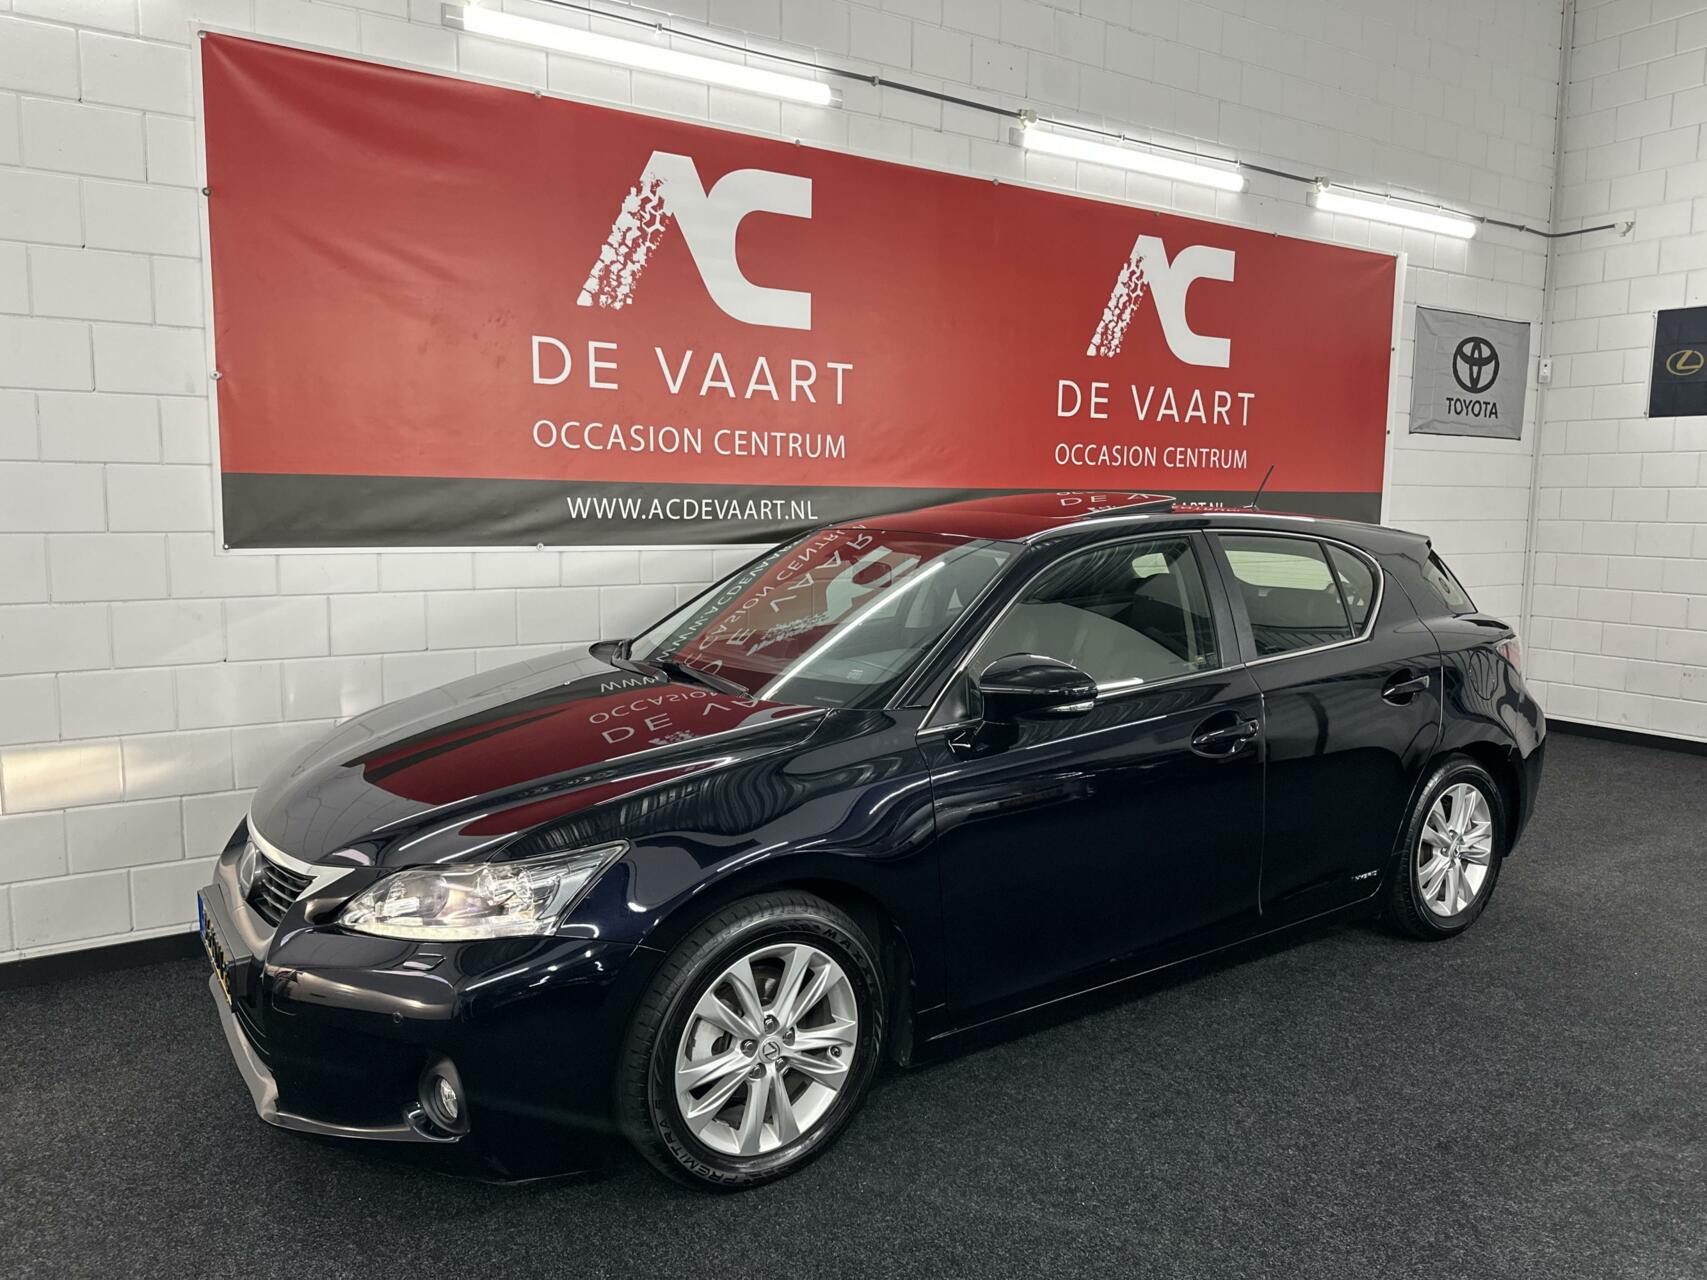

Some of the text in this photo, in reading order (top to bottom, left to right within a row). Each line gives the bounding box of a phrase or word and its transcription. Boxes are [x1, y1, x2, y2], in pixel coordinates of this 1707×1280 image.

[576, 150, 812, 330] AC
[1086, 234, 1236, 369] AC
[532, 335, 854, 405] DE VAART
[1056, 379, 1256, 426] DE VAART
[1446, 396, 1499, 420] TOYOTA
[532, 419, 847, 459] OCCASION CENTRUM
[1054, 443, 1248, 469] OCCASION CENTRUM
[566, 496, 819, 521] WWW.ACDEVAART.NL
